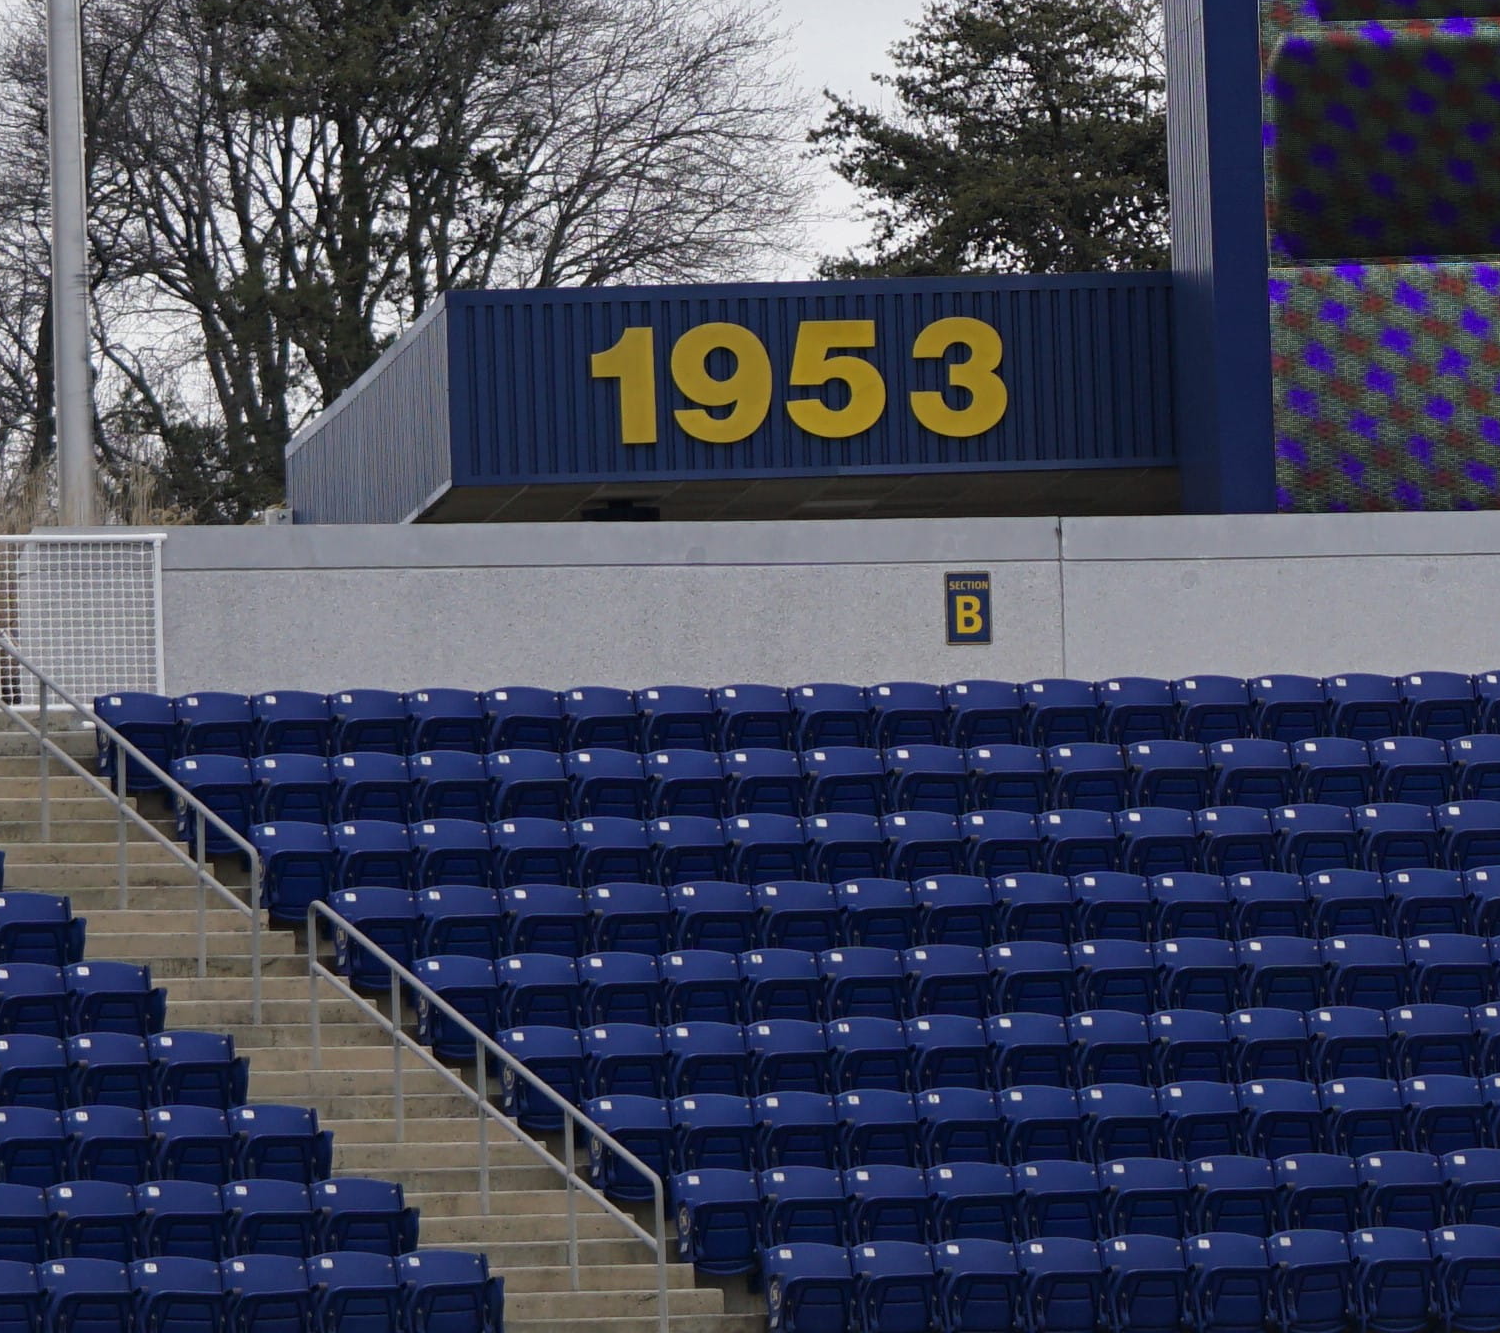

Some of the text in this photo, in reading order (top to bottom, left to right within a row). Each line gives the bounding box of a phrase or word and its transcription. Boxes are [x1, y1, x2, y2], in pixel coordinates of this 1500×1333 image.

[590, 316, 1009, 446] 1953
[949, 580, 989, 590] SECTION
[955, 595, 983, 634] B
